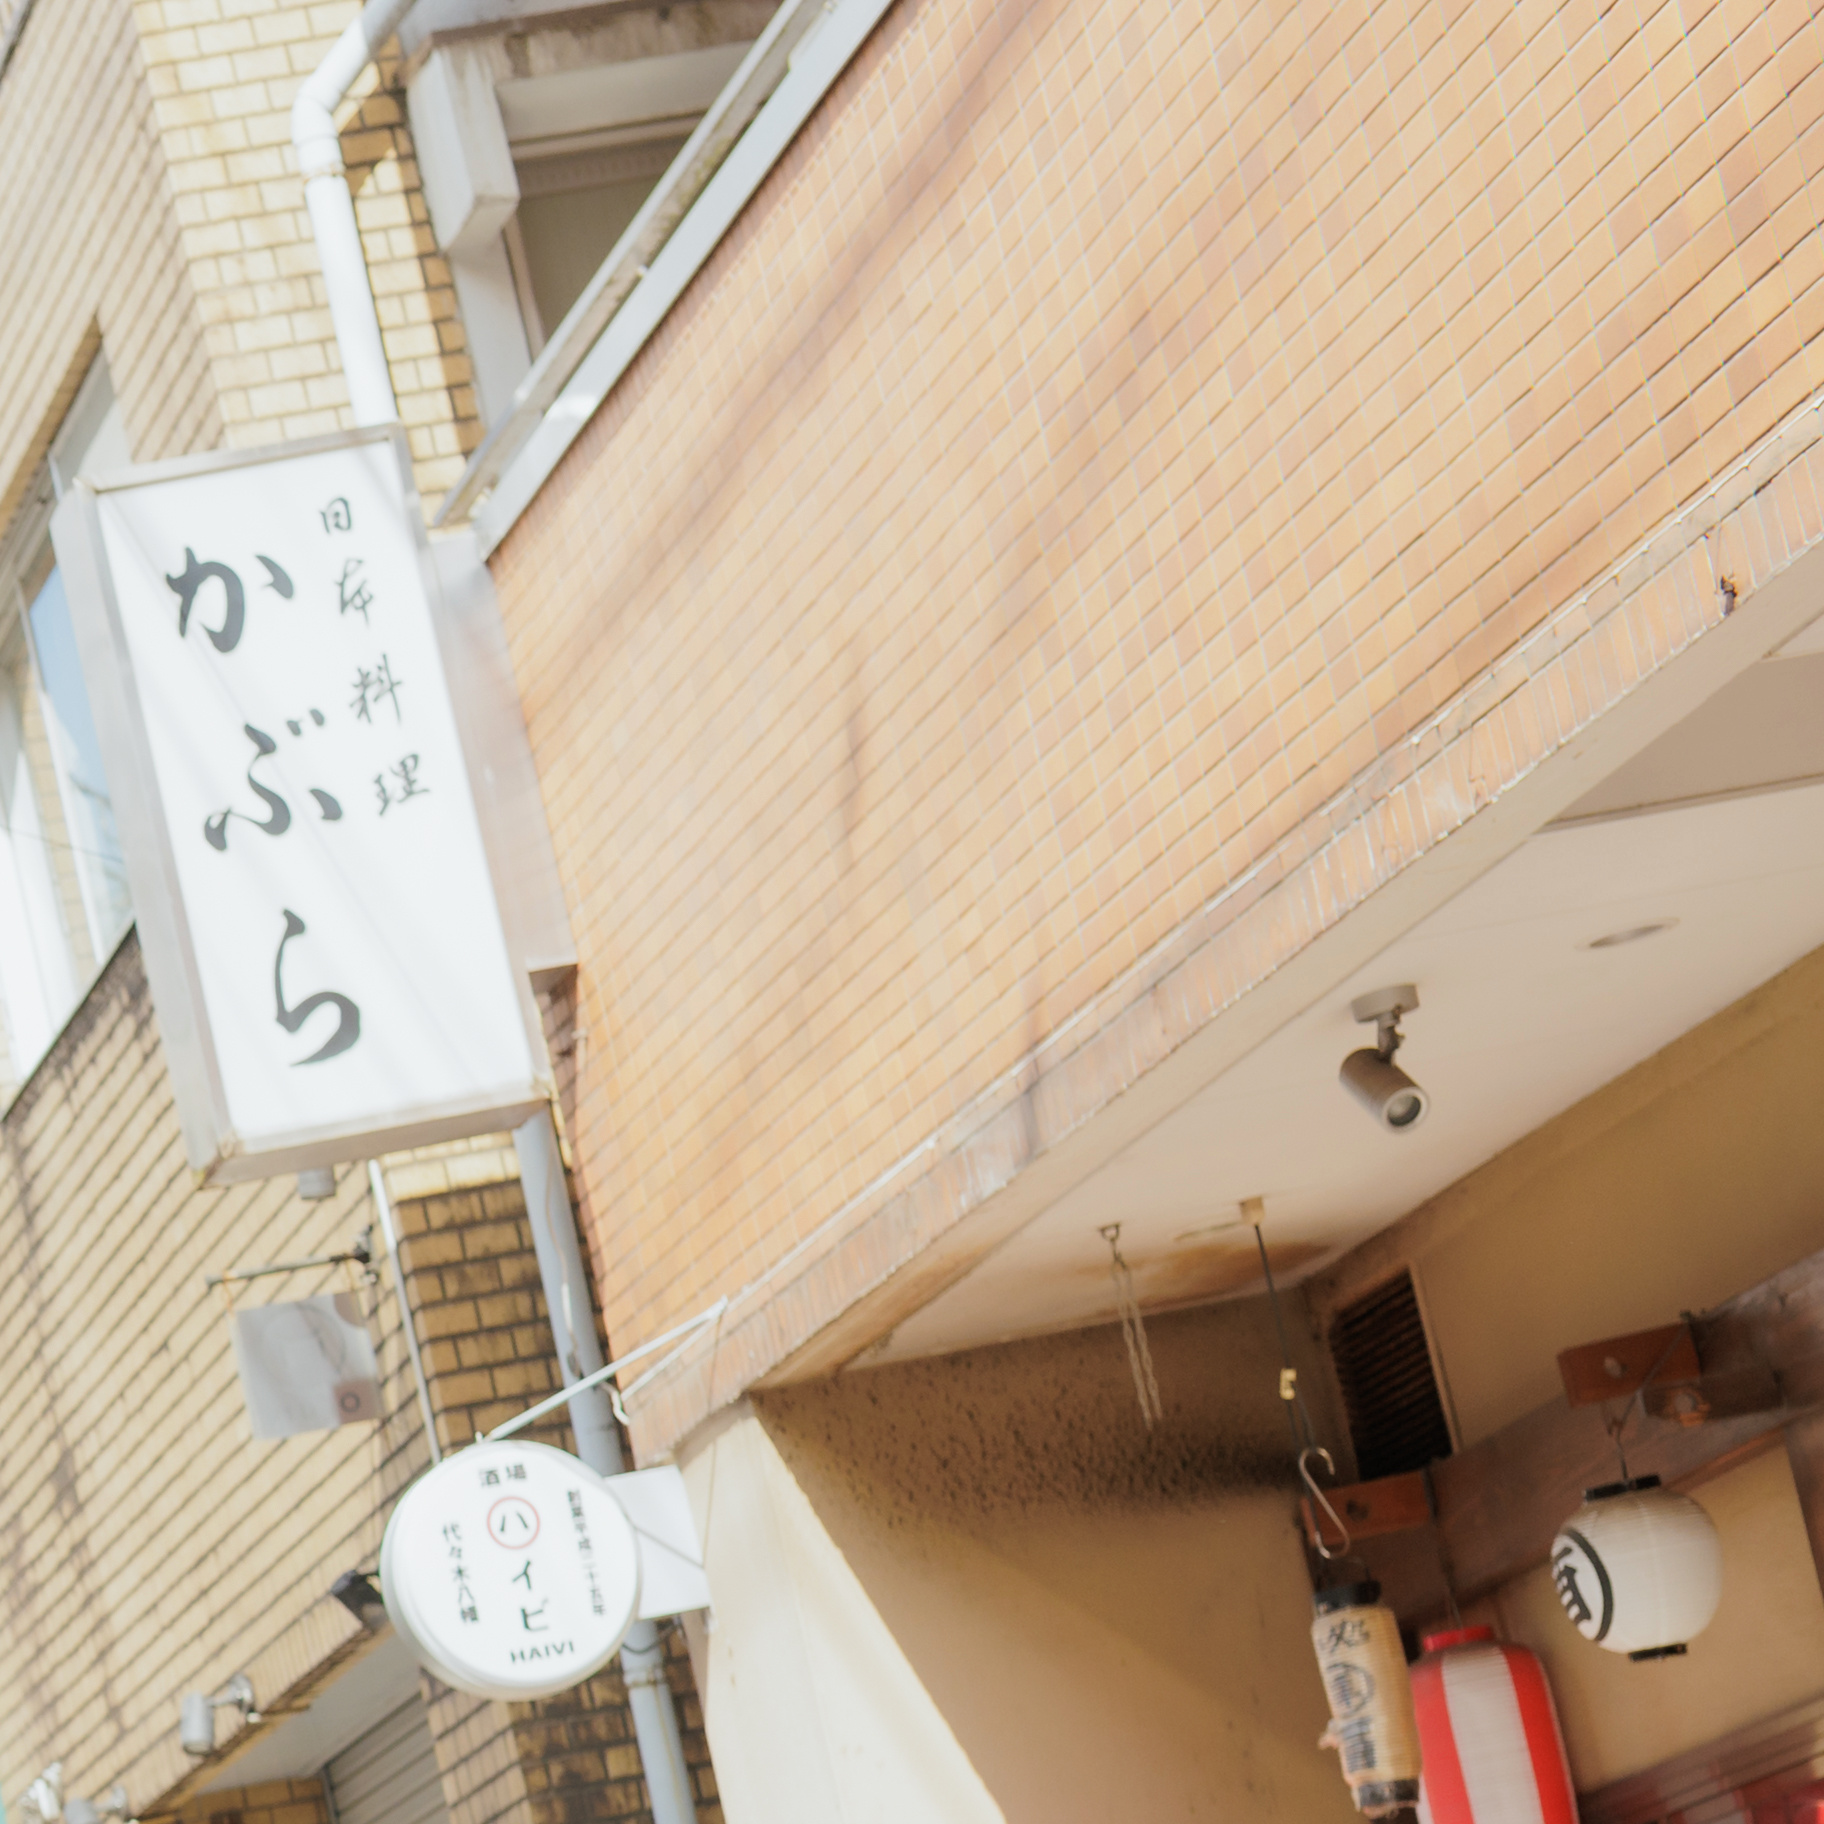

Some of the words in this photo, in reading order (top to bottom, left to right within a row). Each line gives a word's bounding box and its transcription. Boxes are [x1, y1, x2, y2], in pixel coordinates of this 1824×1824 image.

[319, 496, 430, 817] 日本料理
[165, 546, 361, 1067] かぶら
[479, 1463, 527, 1487] 酒場
[509, 1639, 575, 1664] HAIVI
